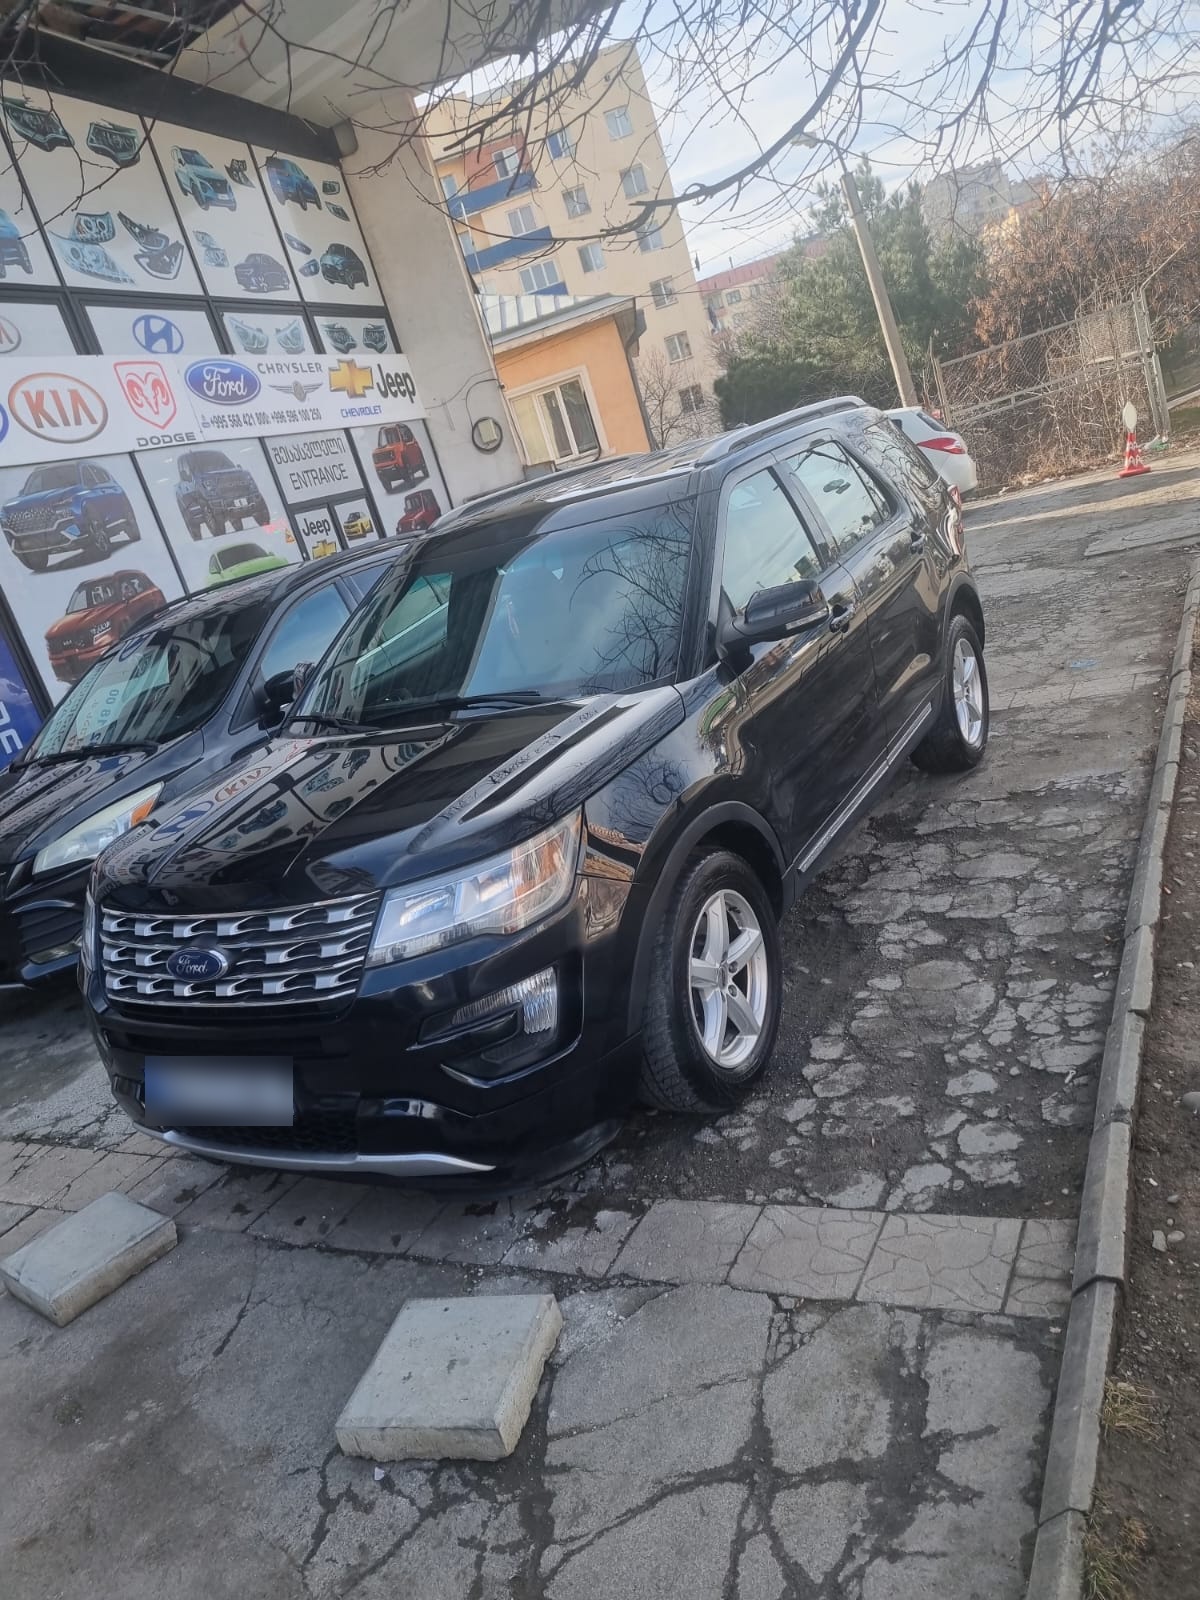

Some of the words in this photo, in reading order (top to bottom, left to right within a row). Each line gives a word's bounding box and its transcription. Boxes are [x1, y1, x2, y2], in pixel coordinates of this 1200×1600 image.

[257, 362, 323, 375] CHRYSLER
[203, 366, 247, 397] Ford
[376, 363, 416, 403] Jeep
[22, 389, 98, 428] KIA
[340, 405, 382, 418] CHEVROLET
[136, 432, 197, 447] DODGE
[272, 437, 346, 465] შესასვლელი
[289, 463, 348, 490] ENTRANCE
[302, 518, 331, 536] Jeep
[176, 954, 208, 975] Ford
